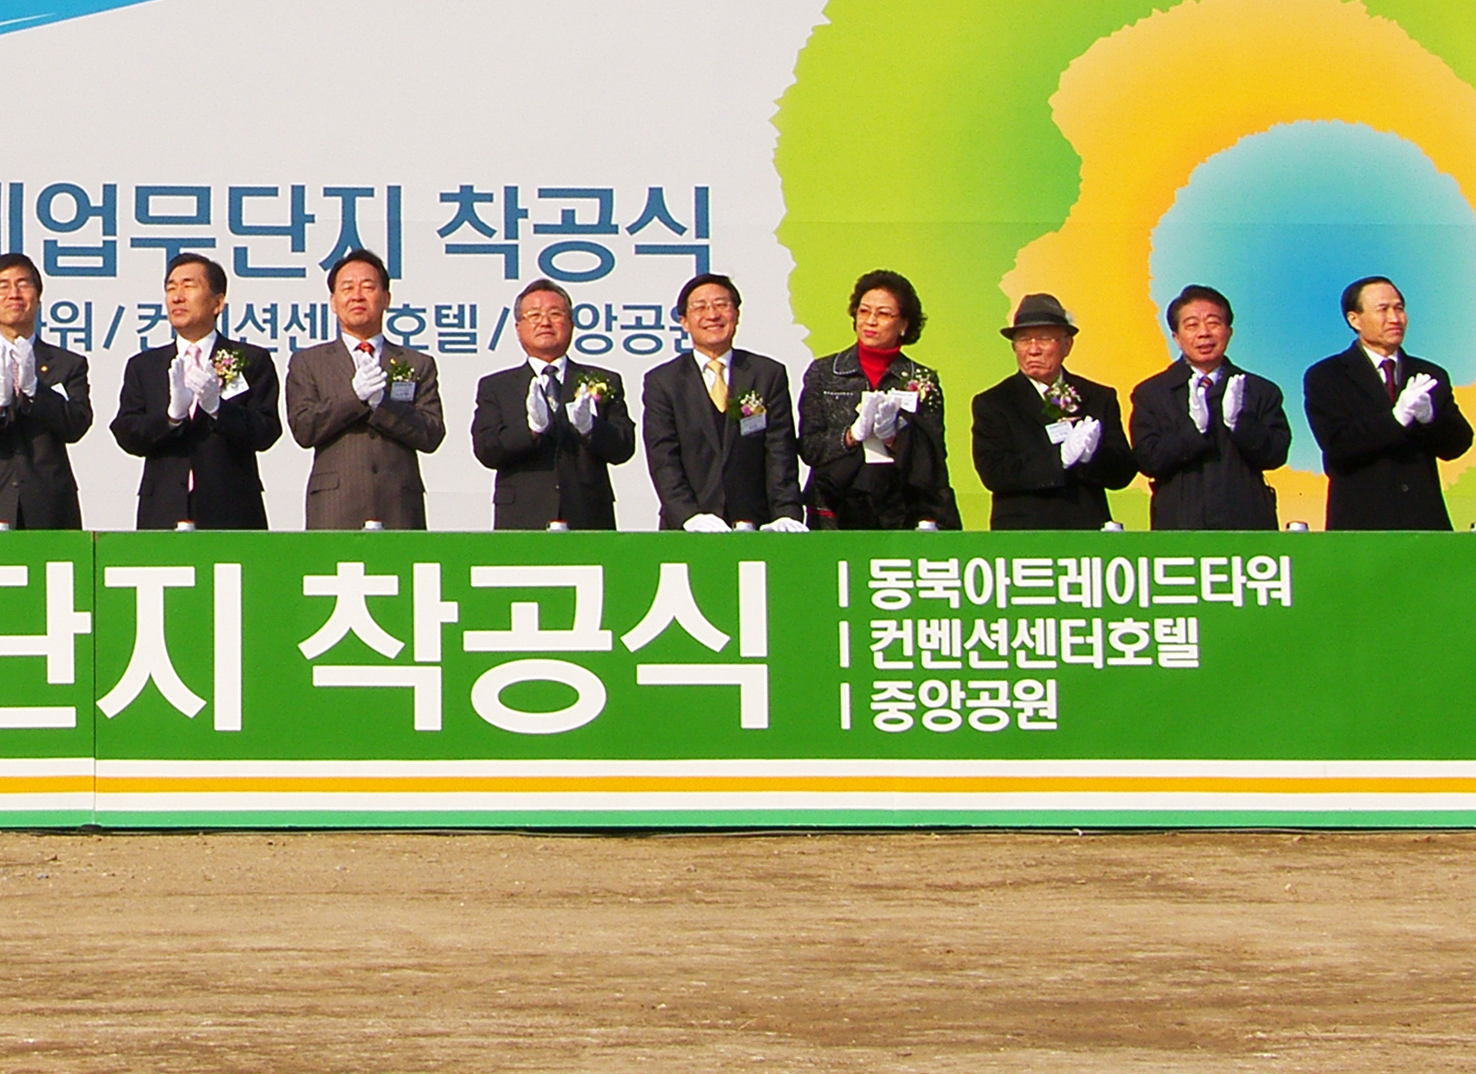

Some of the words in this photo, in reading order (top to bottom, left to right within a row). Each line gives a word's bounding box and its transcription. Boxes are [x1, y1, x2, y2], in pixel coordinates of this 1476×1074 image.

[436, 184, 712, 282] 착공식
[867, 555, 1294, 611] 동북아트레이드타워
[297, 561, 770, 735] 착공식
[869, 616, 1201, 671] 컨벤션센터호텔
[870, 678, 1060, 734] 중앙공원
